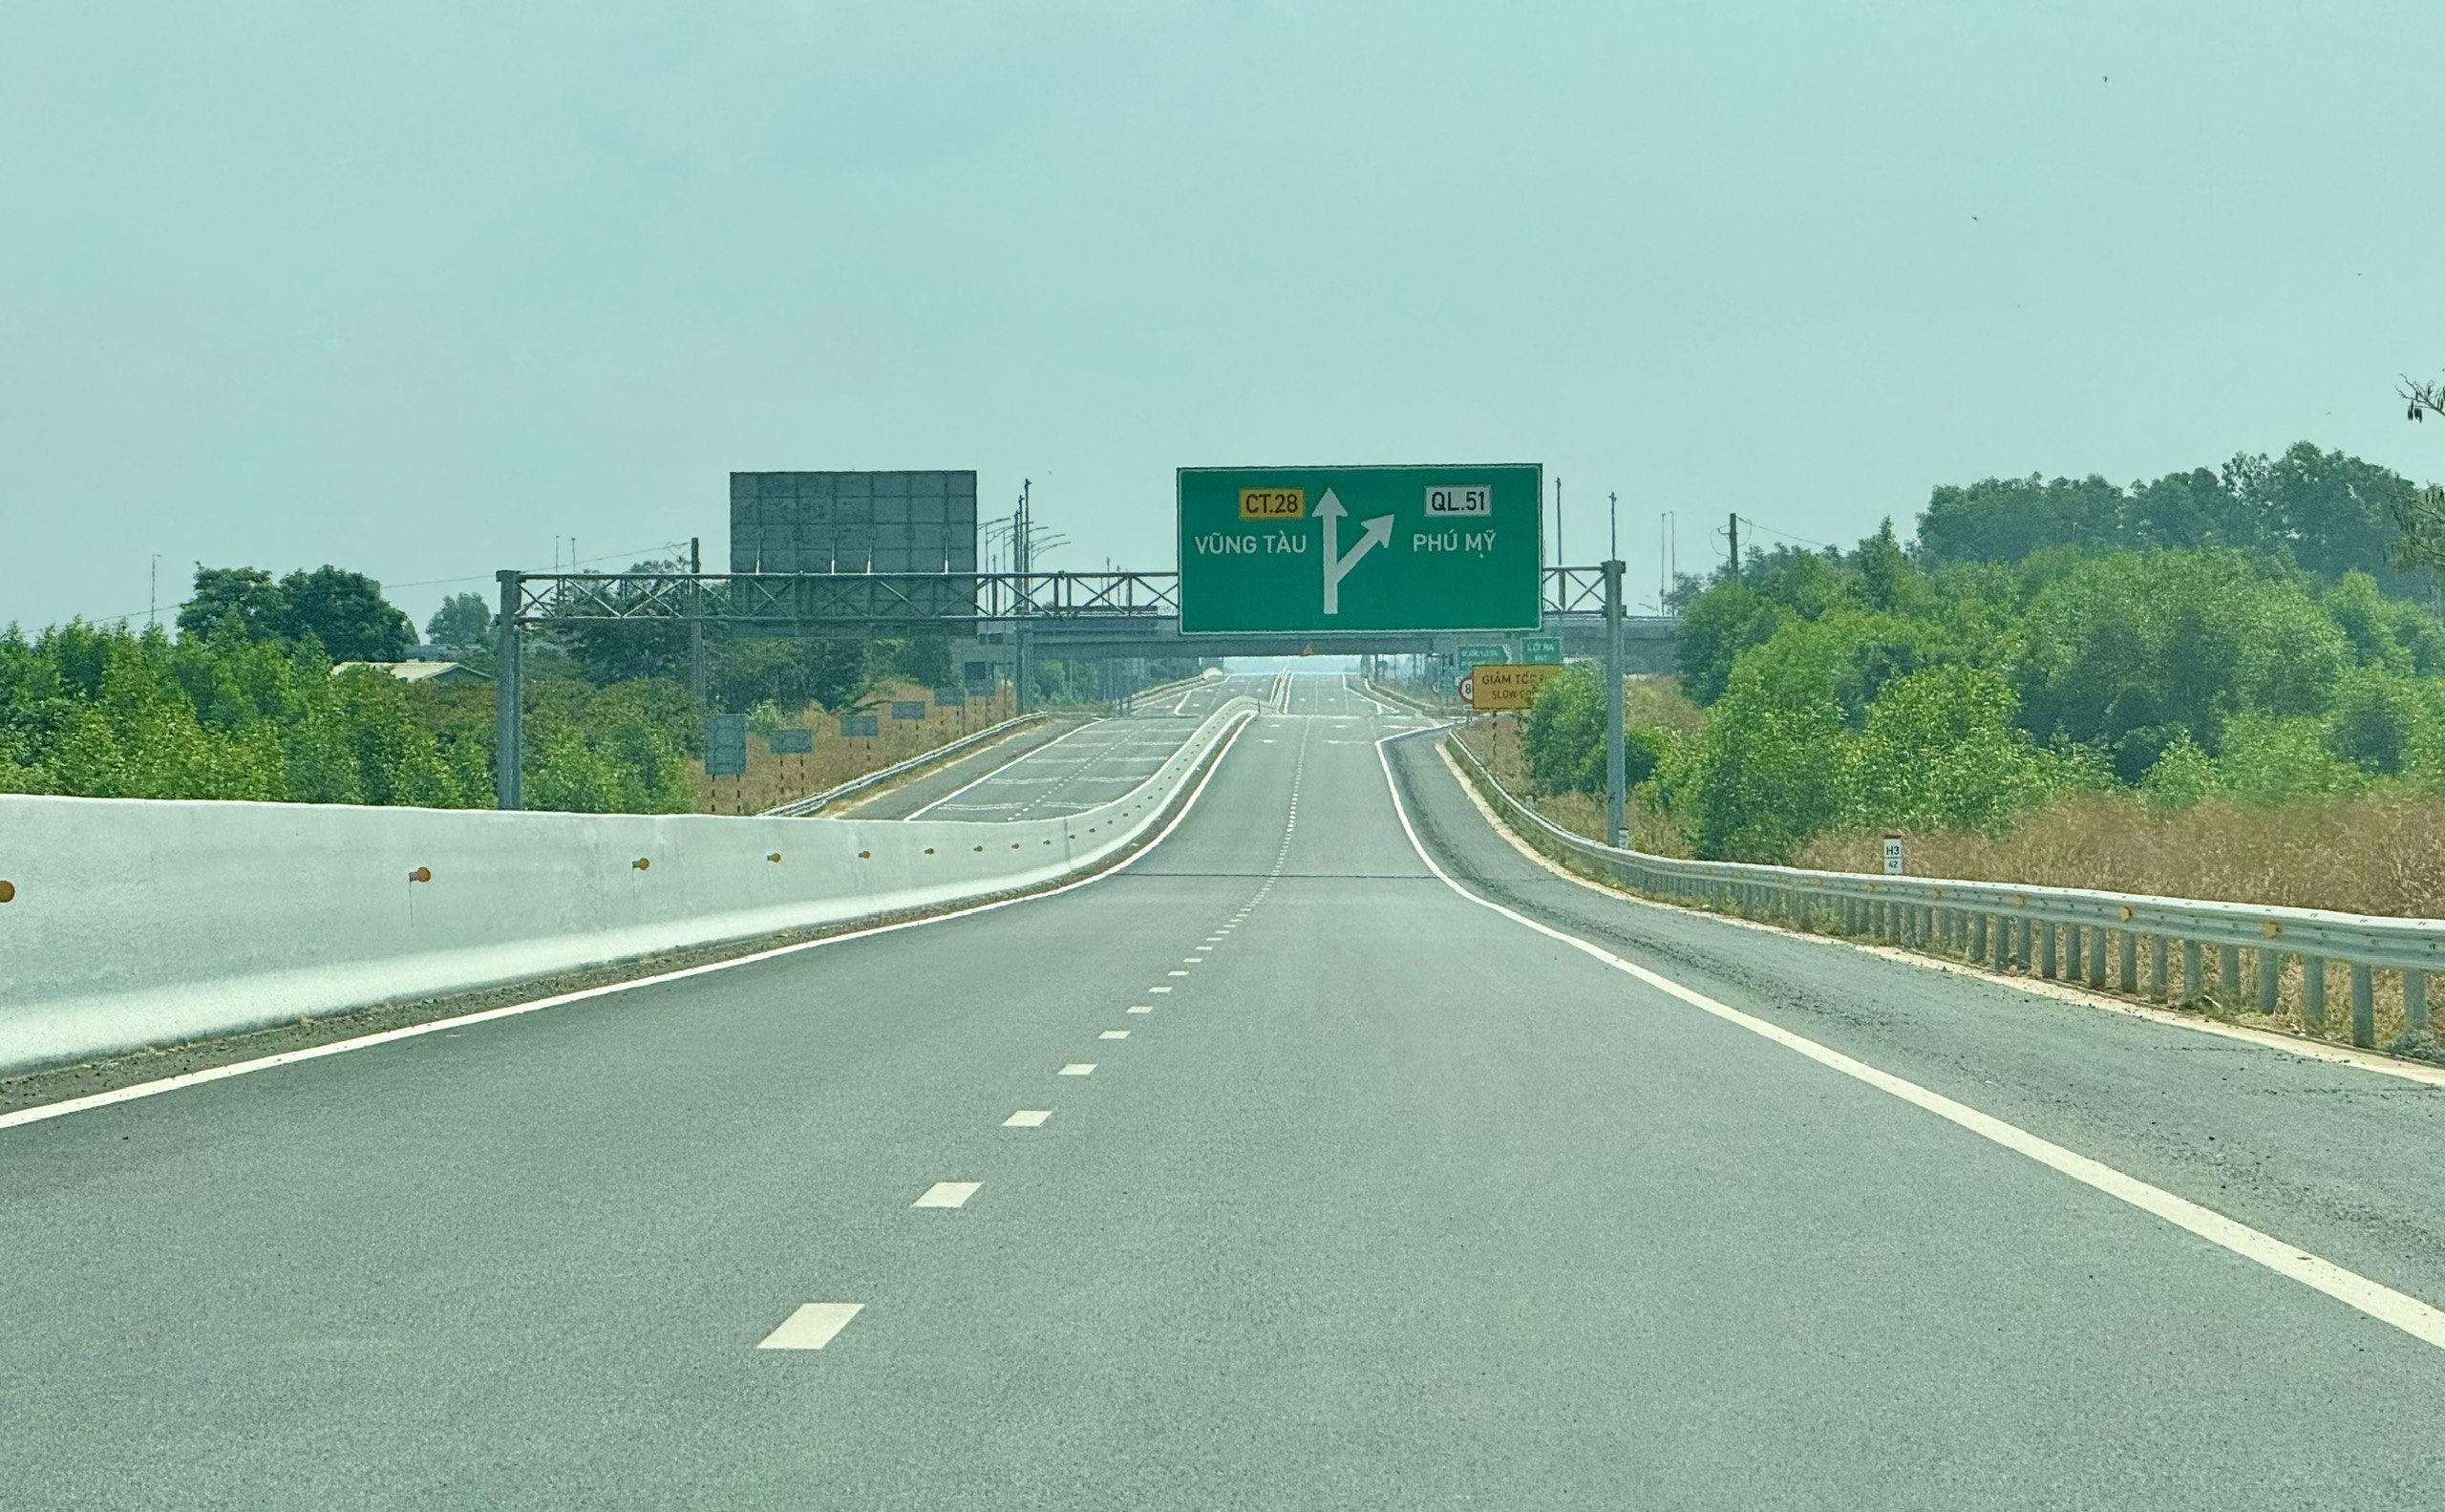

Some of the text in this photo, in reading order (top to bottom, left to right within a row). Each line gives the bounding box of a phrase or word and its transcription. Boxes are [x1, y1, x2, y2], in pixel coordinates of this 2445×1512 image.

[1245, 494, 1298, 513] CT.28
[1432, 491, 1484, 511] QL.51
[1195, 530, 1307, 554] VŨNG TÀU
[1414, 528, 1497, 552] PHÚ MỸ
[1482, 671, 1511, 685] GIẢM
[1491, 690, 1517, 700] SLOW
[1886, 845, 1900, 856] H3
